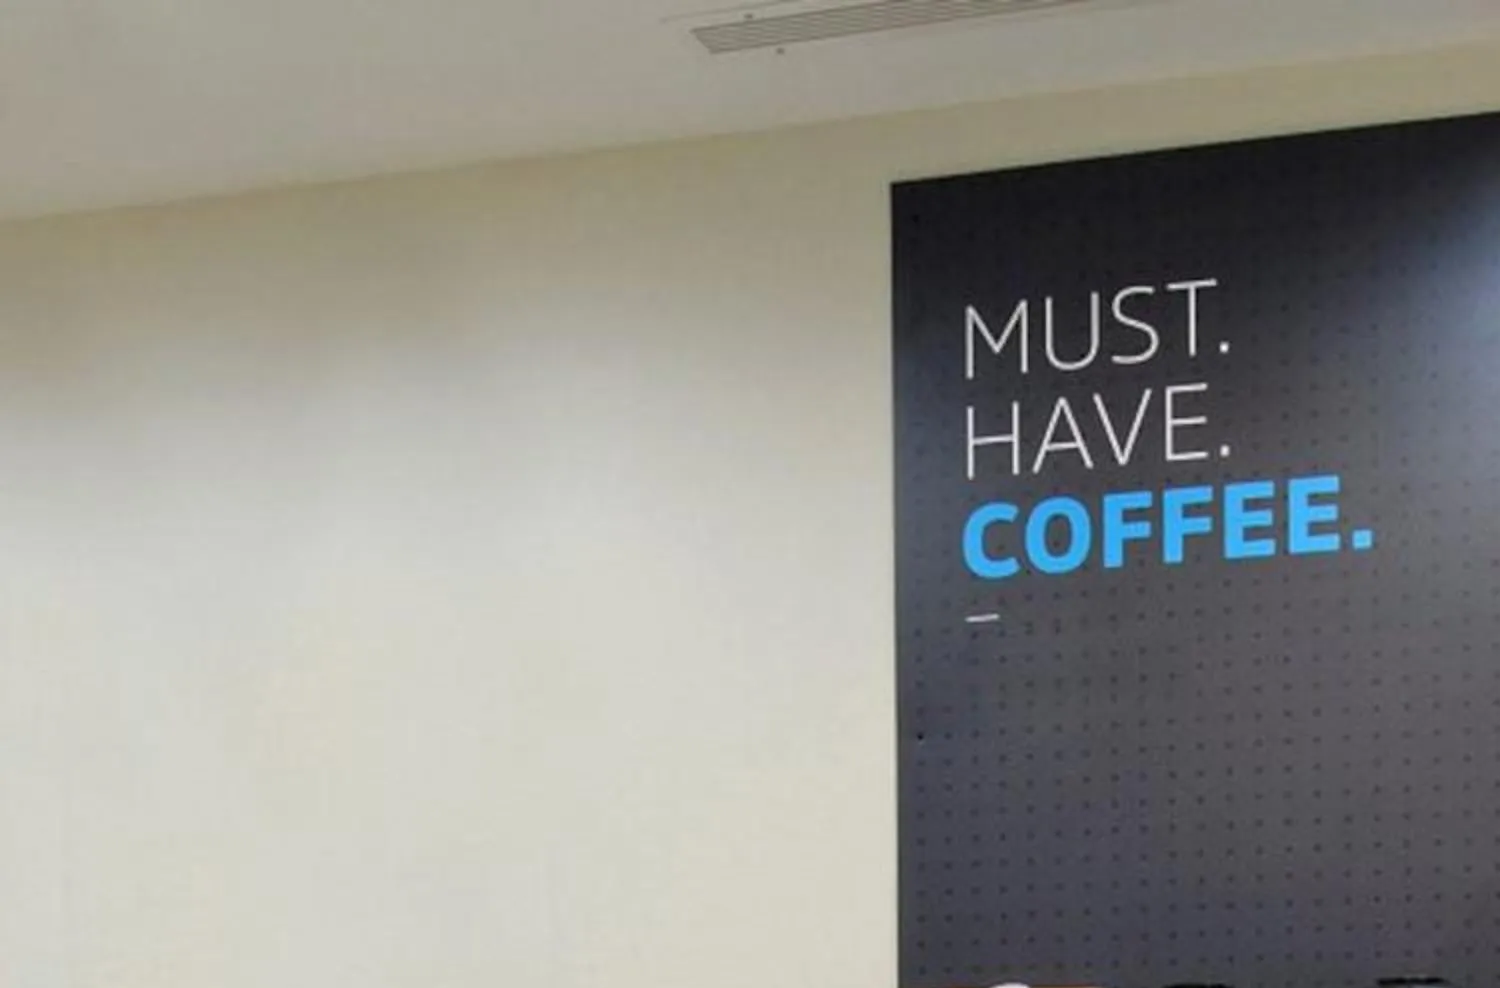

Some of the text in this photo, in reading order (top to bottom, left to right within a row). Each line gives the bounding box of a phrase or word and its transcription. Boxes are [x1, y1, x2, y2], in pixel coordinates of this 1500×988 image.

[965, 278, 1230, 380] MUST.
[965, 382, 1230, 480] HAVE.
[962, 474, 1373, 579] COFFEE.
